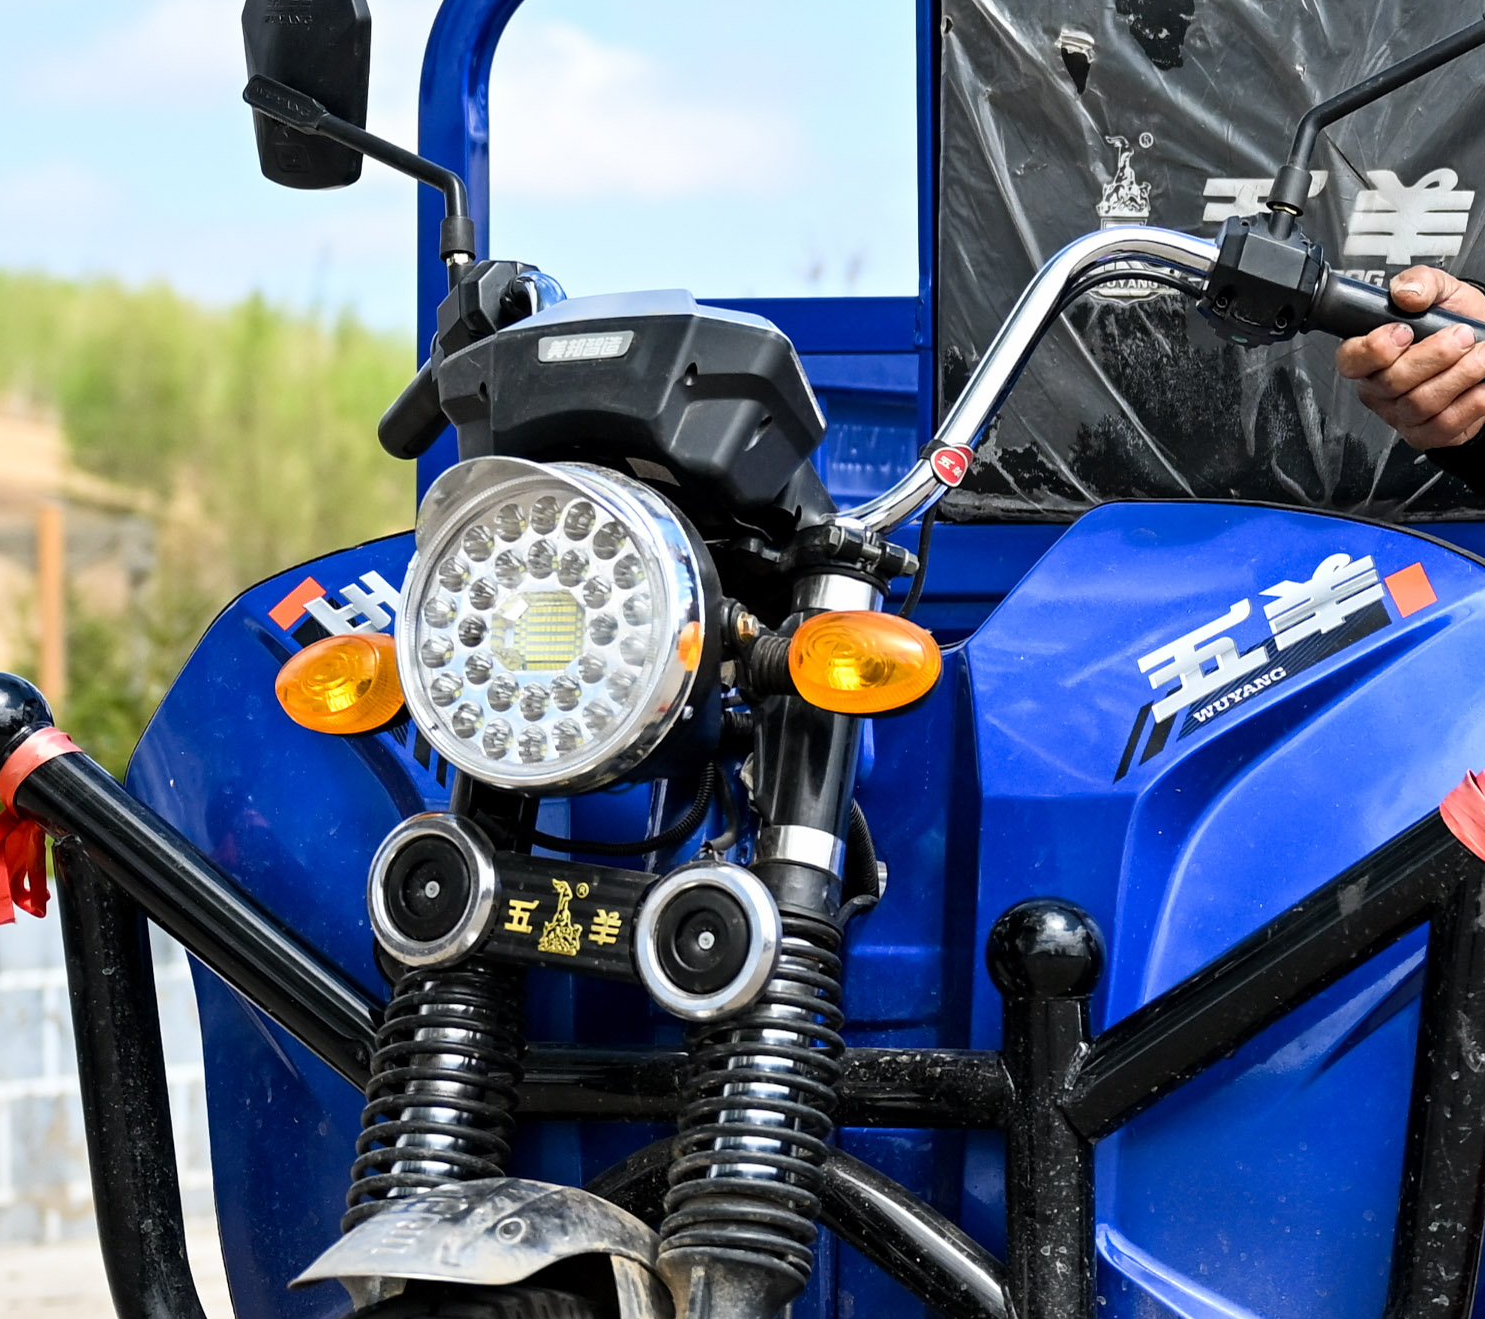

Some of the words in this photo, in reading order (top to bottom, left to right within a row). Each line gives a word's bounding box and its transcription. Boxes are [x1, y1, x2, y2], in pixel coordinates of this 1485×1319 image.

[547, 336, 623, 359] 美邦智造
[1137, 553, 1386, 723] 五羊
[1193, 666, 1287, 723] WUYANG
